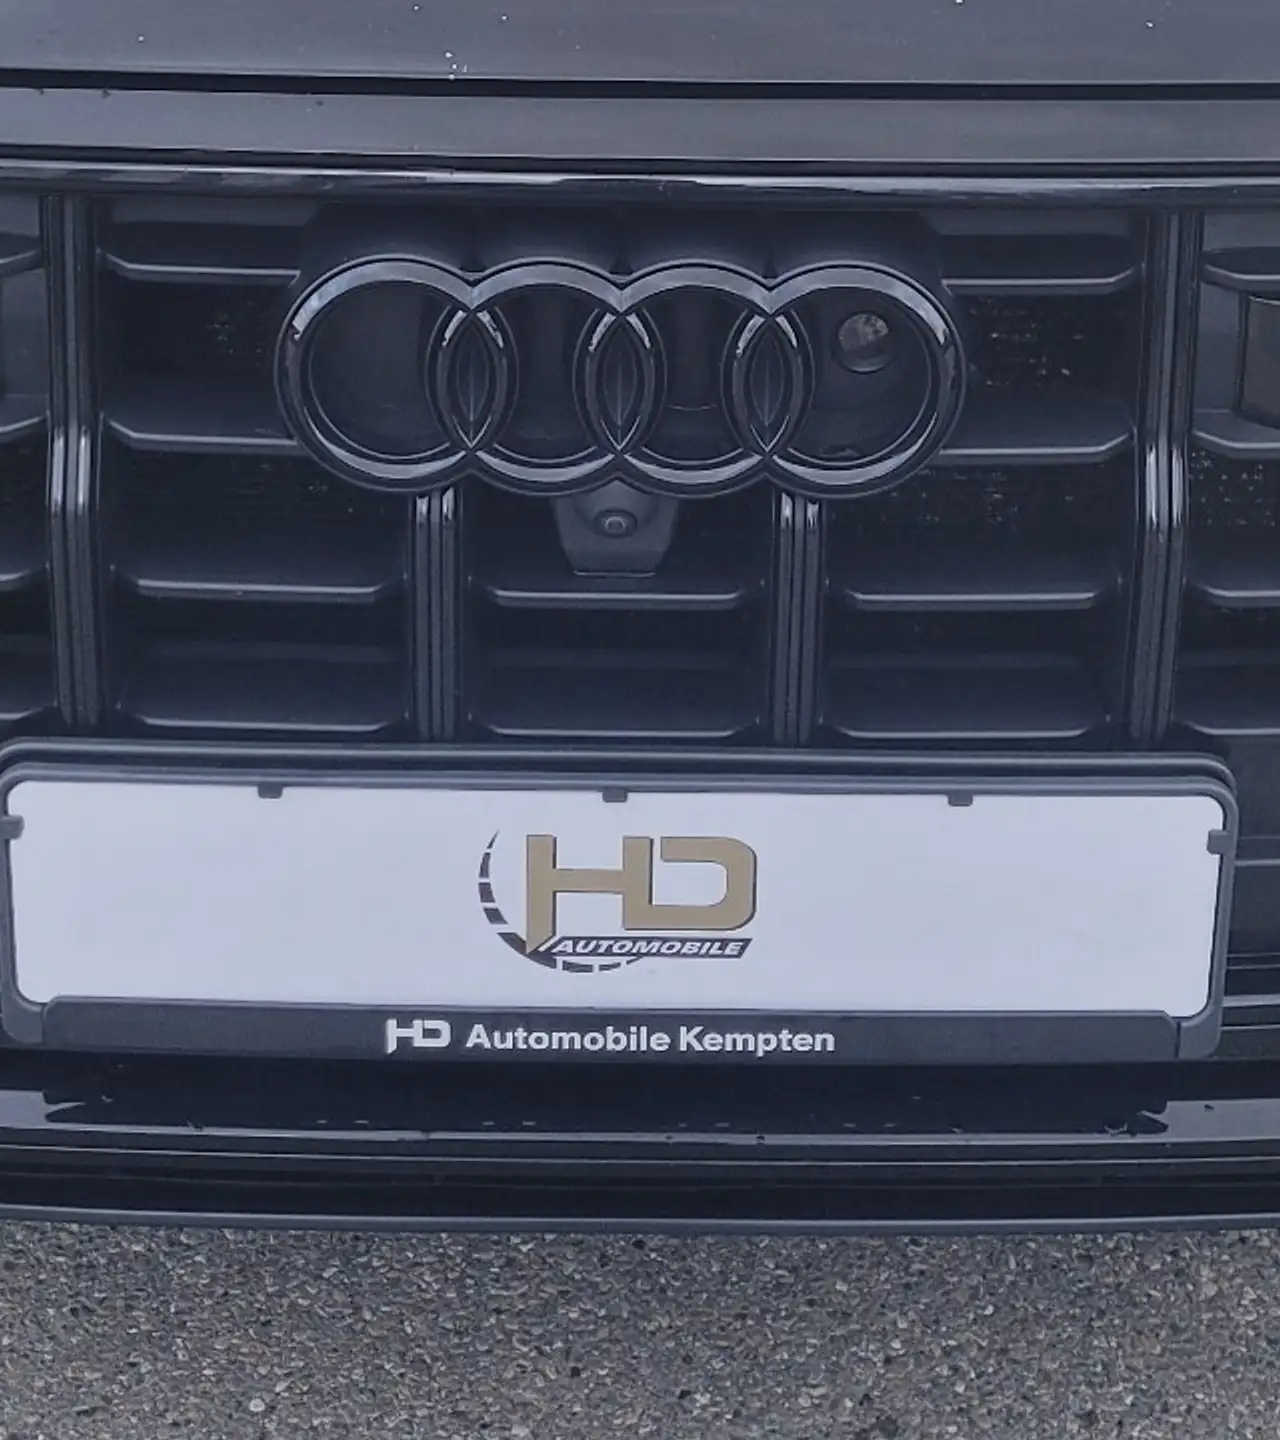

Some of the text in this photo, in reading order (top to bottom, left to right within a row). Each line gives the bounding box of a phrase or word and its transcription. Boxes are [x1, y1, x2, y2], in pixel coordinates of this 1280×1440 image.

[525, 834, 757, 954] HD
[551, 939, 745, 956] AUTOMOBILE
[385, 1018, 836, 1057] HD Automobile Kempten
